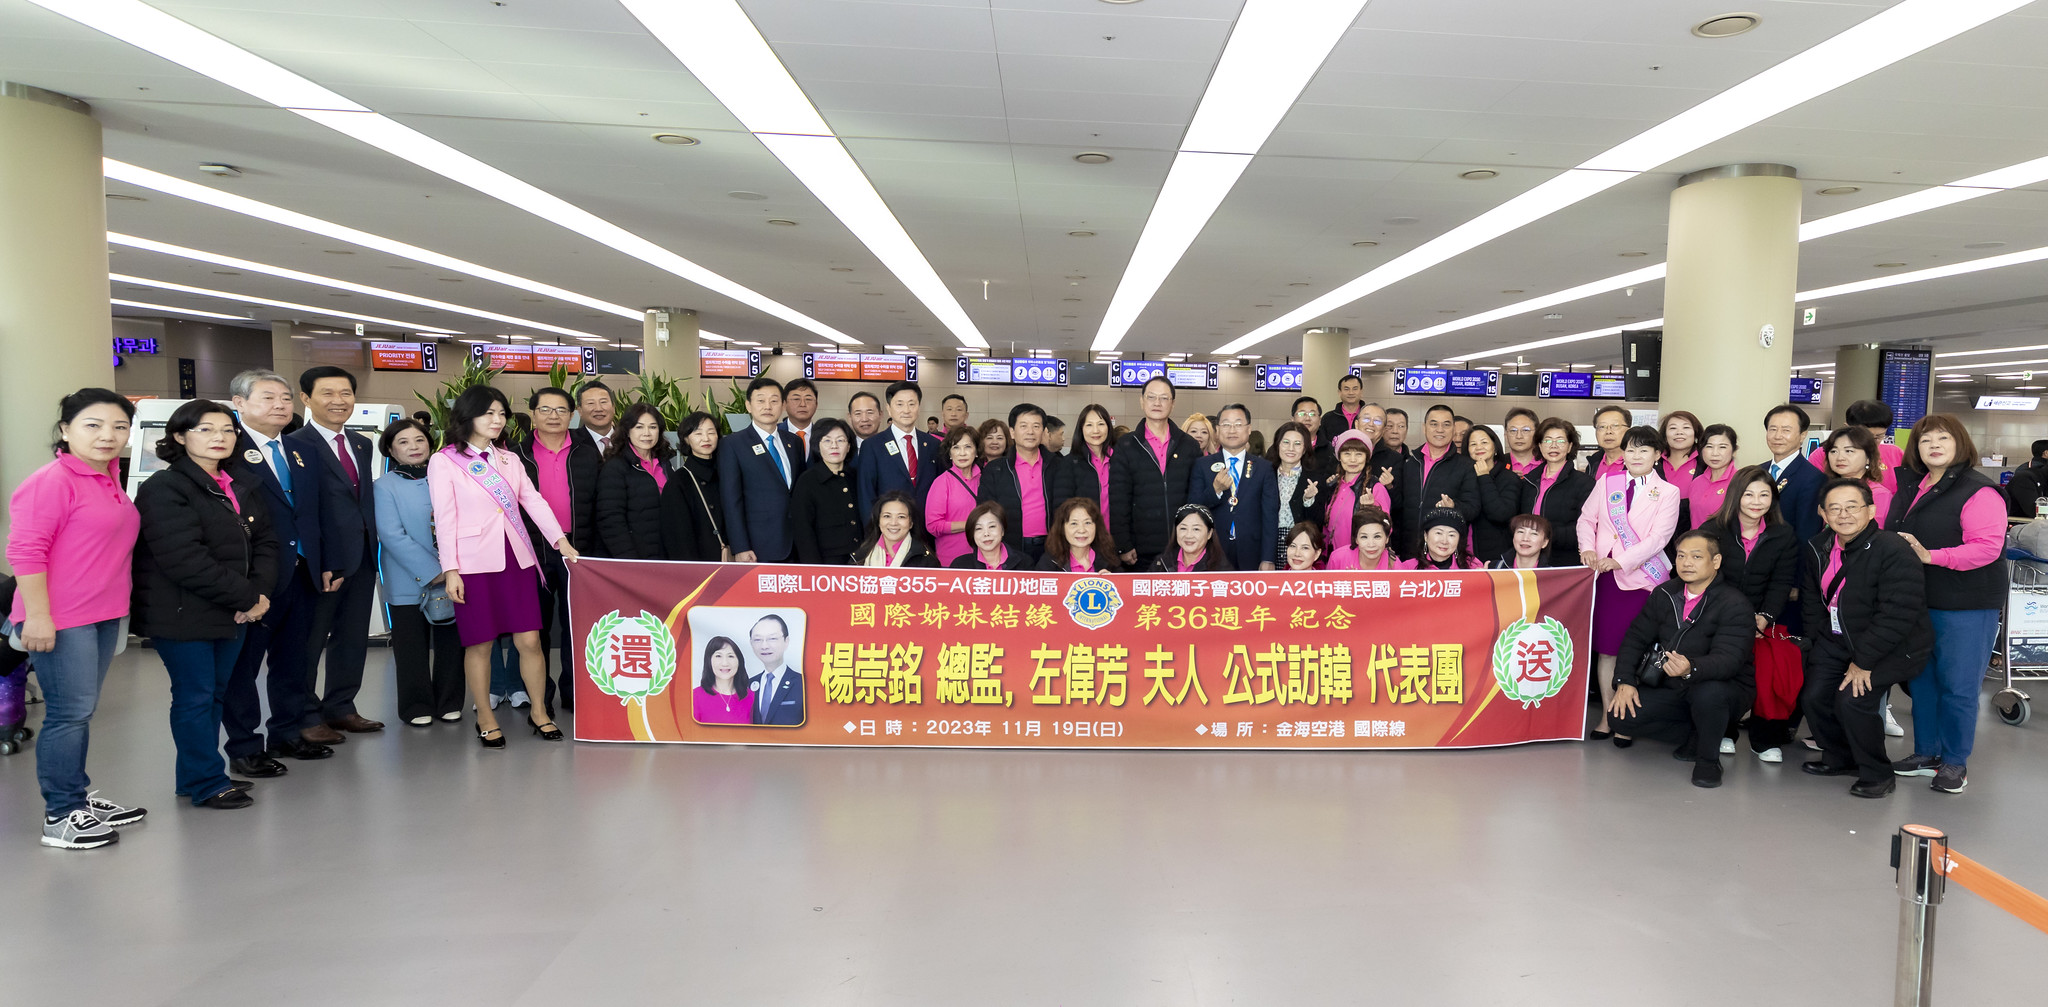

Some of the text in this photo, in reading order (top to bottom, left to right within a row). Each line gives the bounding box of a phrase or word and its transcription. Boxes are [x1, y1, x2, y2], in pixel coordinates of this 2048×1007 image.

[424, 346, 433, 355] C
[474, 346, 482, 356] C
[584, 350, 592, 359] C
[751, 354, 758, 362] C
[805, 356, 812, 364] C
[908, 358, 916, 367] C
[427, 359, 433, 367] 1
[586, 362, 592, 371] 3
[959, 359, 966, 368] C
[1059, 362, 1066, 370] C
[1112, 363, 1119, 372] C
[752, 365, 758, 374] 5
[806, 367, 812, 376] 6
[909, 370, 915, 378] 7
[1210, 366, 1217, 374] C
[1258, 367, 1265, 376] C
[959, 371, 965, 379] 8
[1060, 374, 1066, 382] 9
[1397, 371, 1404, 379] C
[1489, 373, 1496, 382] C
[1542, 375, 1549, 383] C
[758, 574, 1058, 596] 國際LIONS協會355-A(釜山)地區
[1078, 580, 1109, 590] LIONS
[1132, 578, 1462, 599] 國際獅子會300-A2(中華民國 台北)區
[1087, 593, 1101, 610] L
[1134, 604, 1356, 632] 第36週年 紀念
[610, 634, 652, 678] 還
[1516, 640, 1555, 683] 送
[820, 641, 1463, 708] 楊崇銘 總監, 左偉芳 夫人 公式訪韓 代表團
[886, 720, 902, 736] 時
[927, 720, 992, 736] 2023年
[1002, 720, 1041, 737] 11月
[1052, 721, 1124, 737] 19日(日)
[1210, 722, 1227, 738] 場
[1236, 722, 1254, 737] 所
[1276, 720, 1345, 737] 金海空港
[1354, 720, 1406, 737] 國際線
